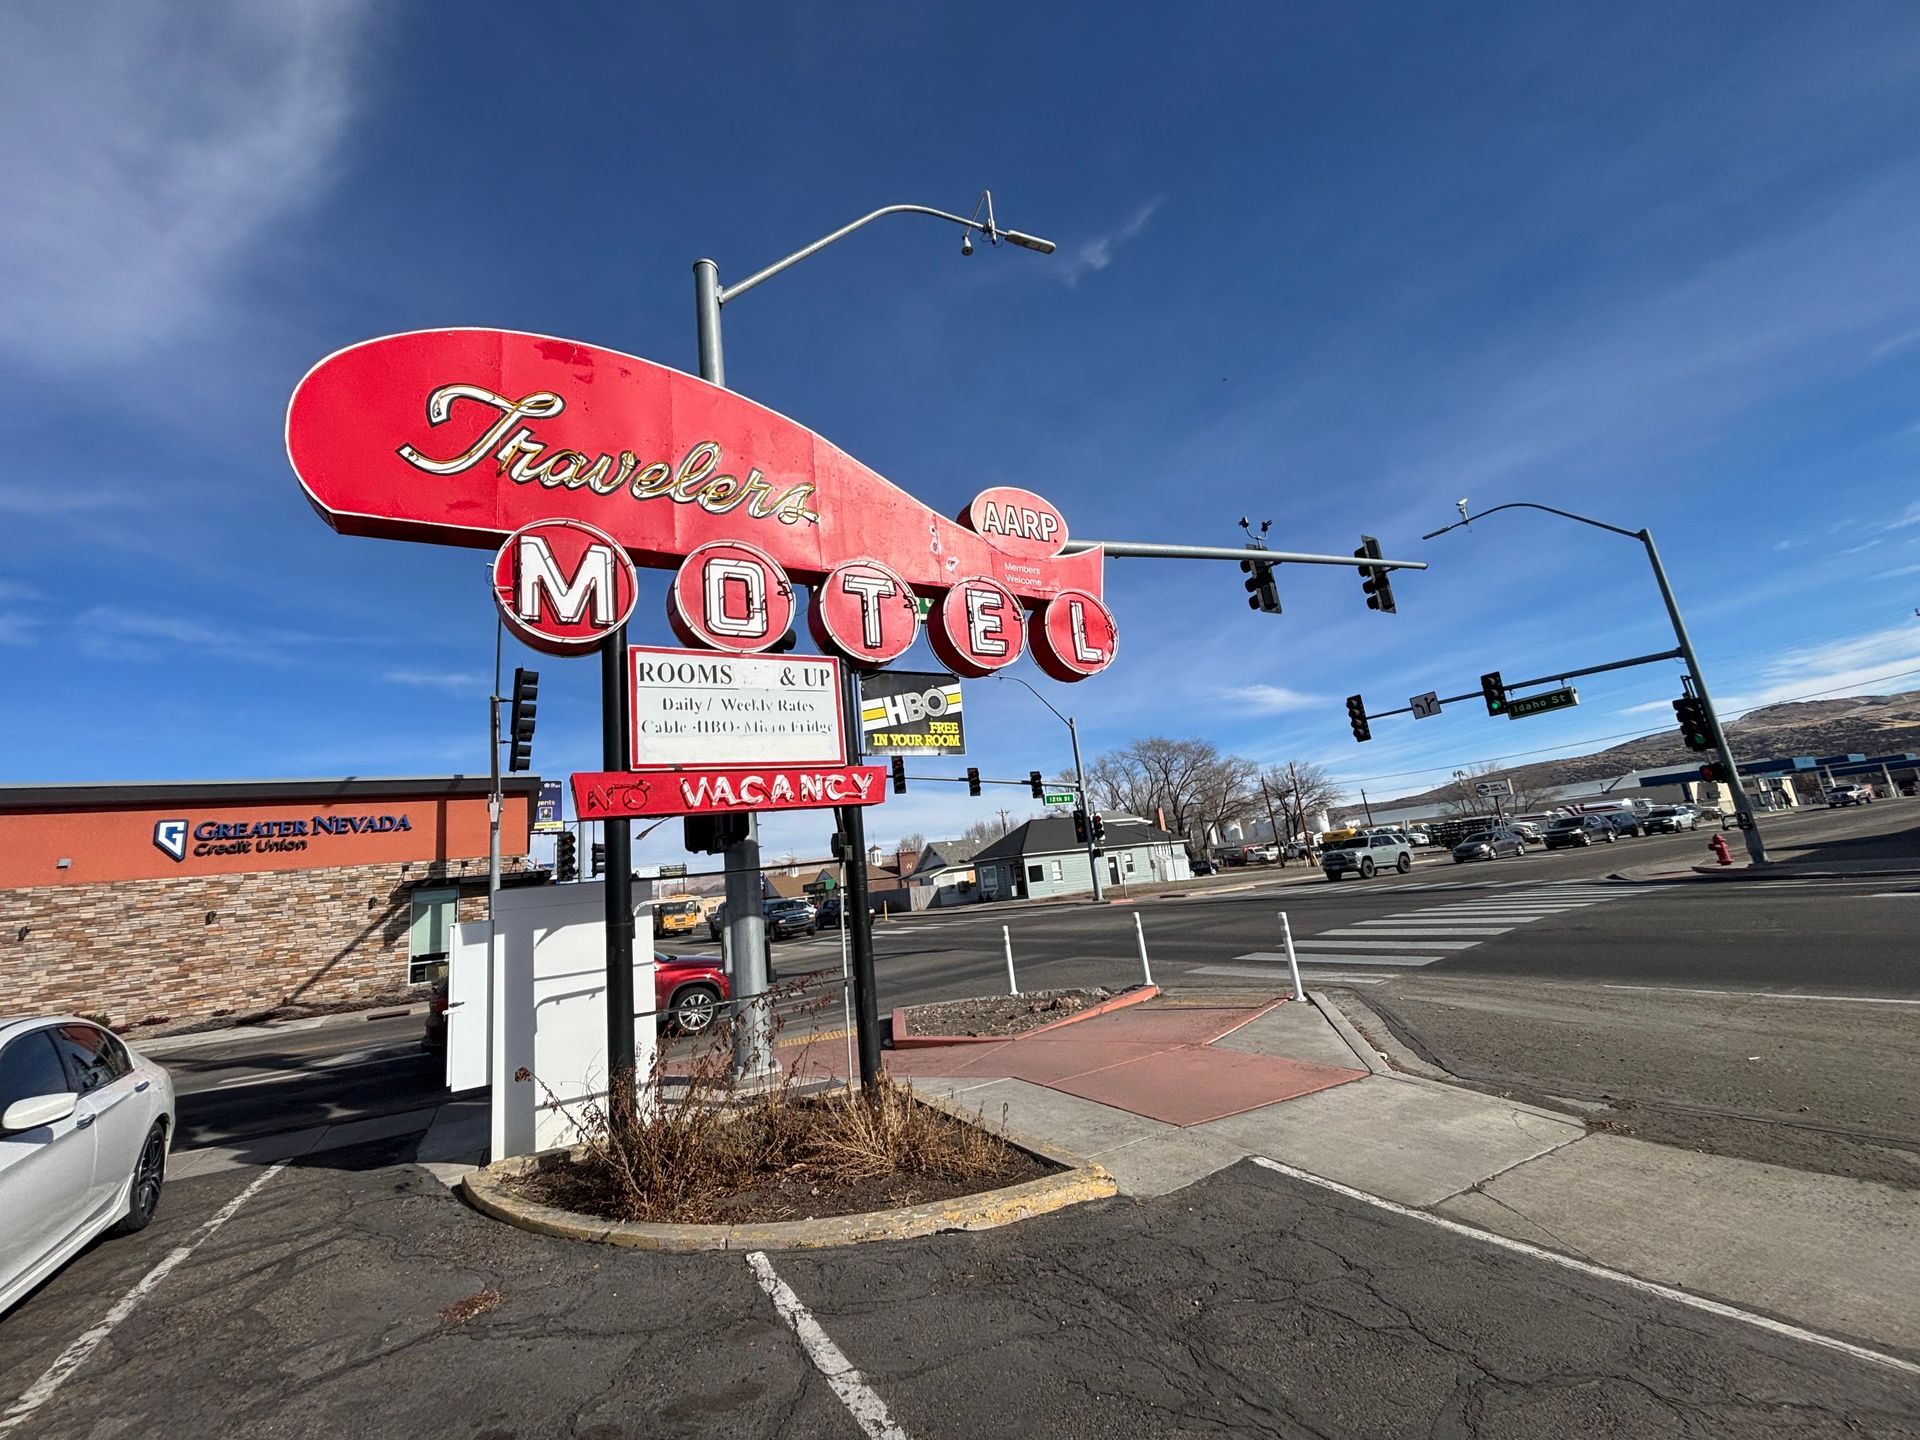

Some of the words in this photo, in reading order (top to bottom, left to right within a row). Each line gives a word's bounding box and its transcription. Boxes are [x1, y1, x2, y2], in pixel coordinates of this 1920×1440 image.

[398, 383, 820, 526] Travelers
[983, 501, 1059, 542] AARP
[1004, 562, 1041, 575] Members
[1005, 574, 1042, 587] Welcome
[639, 662, 733, 684] ROOMS
[780, 667, 797, 687] &
[804, 668, 831, 687] UP
[662, 697, 702, 714] Daily
[720, 698, 774, 714] Weekly
[778, 699, 816, 712] Rates
[883, 688, 948, 727] HBO
[1514, 700, 1547, 713] Idaho
[1551, 694, 1566, 704] St
[641, 720, 687, 734] Cable
[791, 720, 833, 735] Fridge
[929, 721, 960, 734] FREE
[873, 733, 889, 747] IN
[890, 734, 922, 747] YOUR
[924, 734, 961, 747] ROOM
[680, 773, 874, 808] VACANCY
[194, 820, 307, 841] GREATER
[310, 814, 412, 836] NEVADA
[194, 839, 252, 857] Credit
[256, 837, 308, 853] Union
